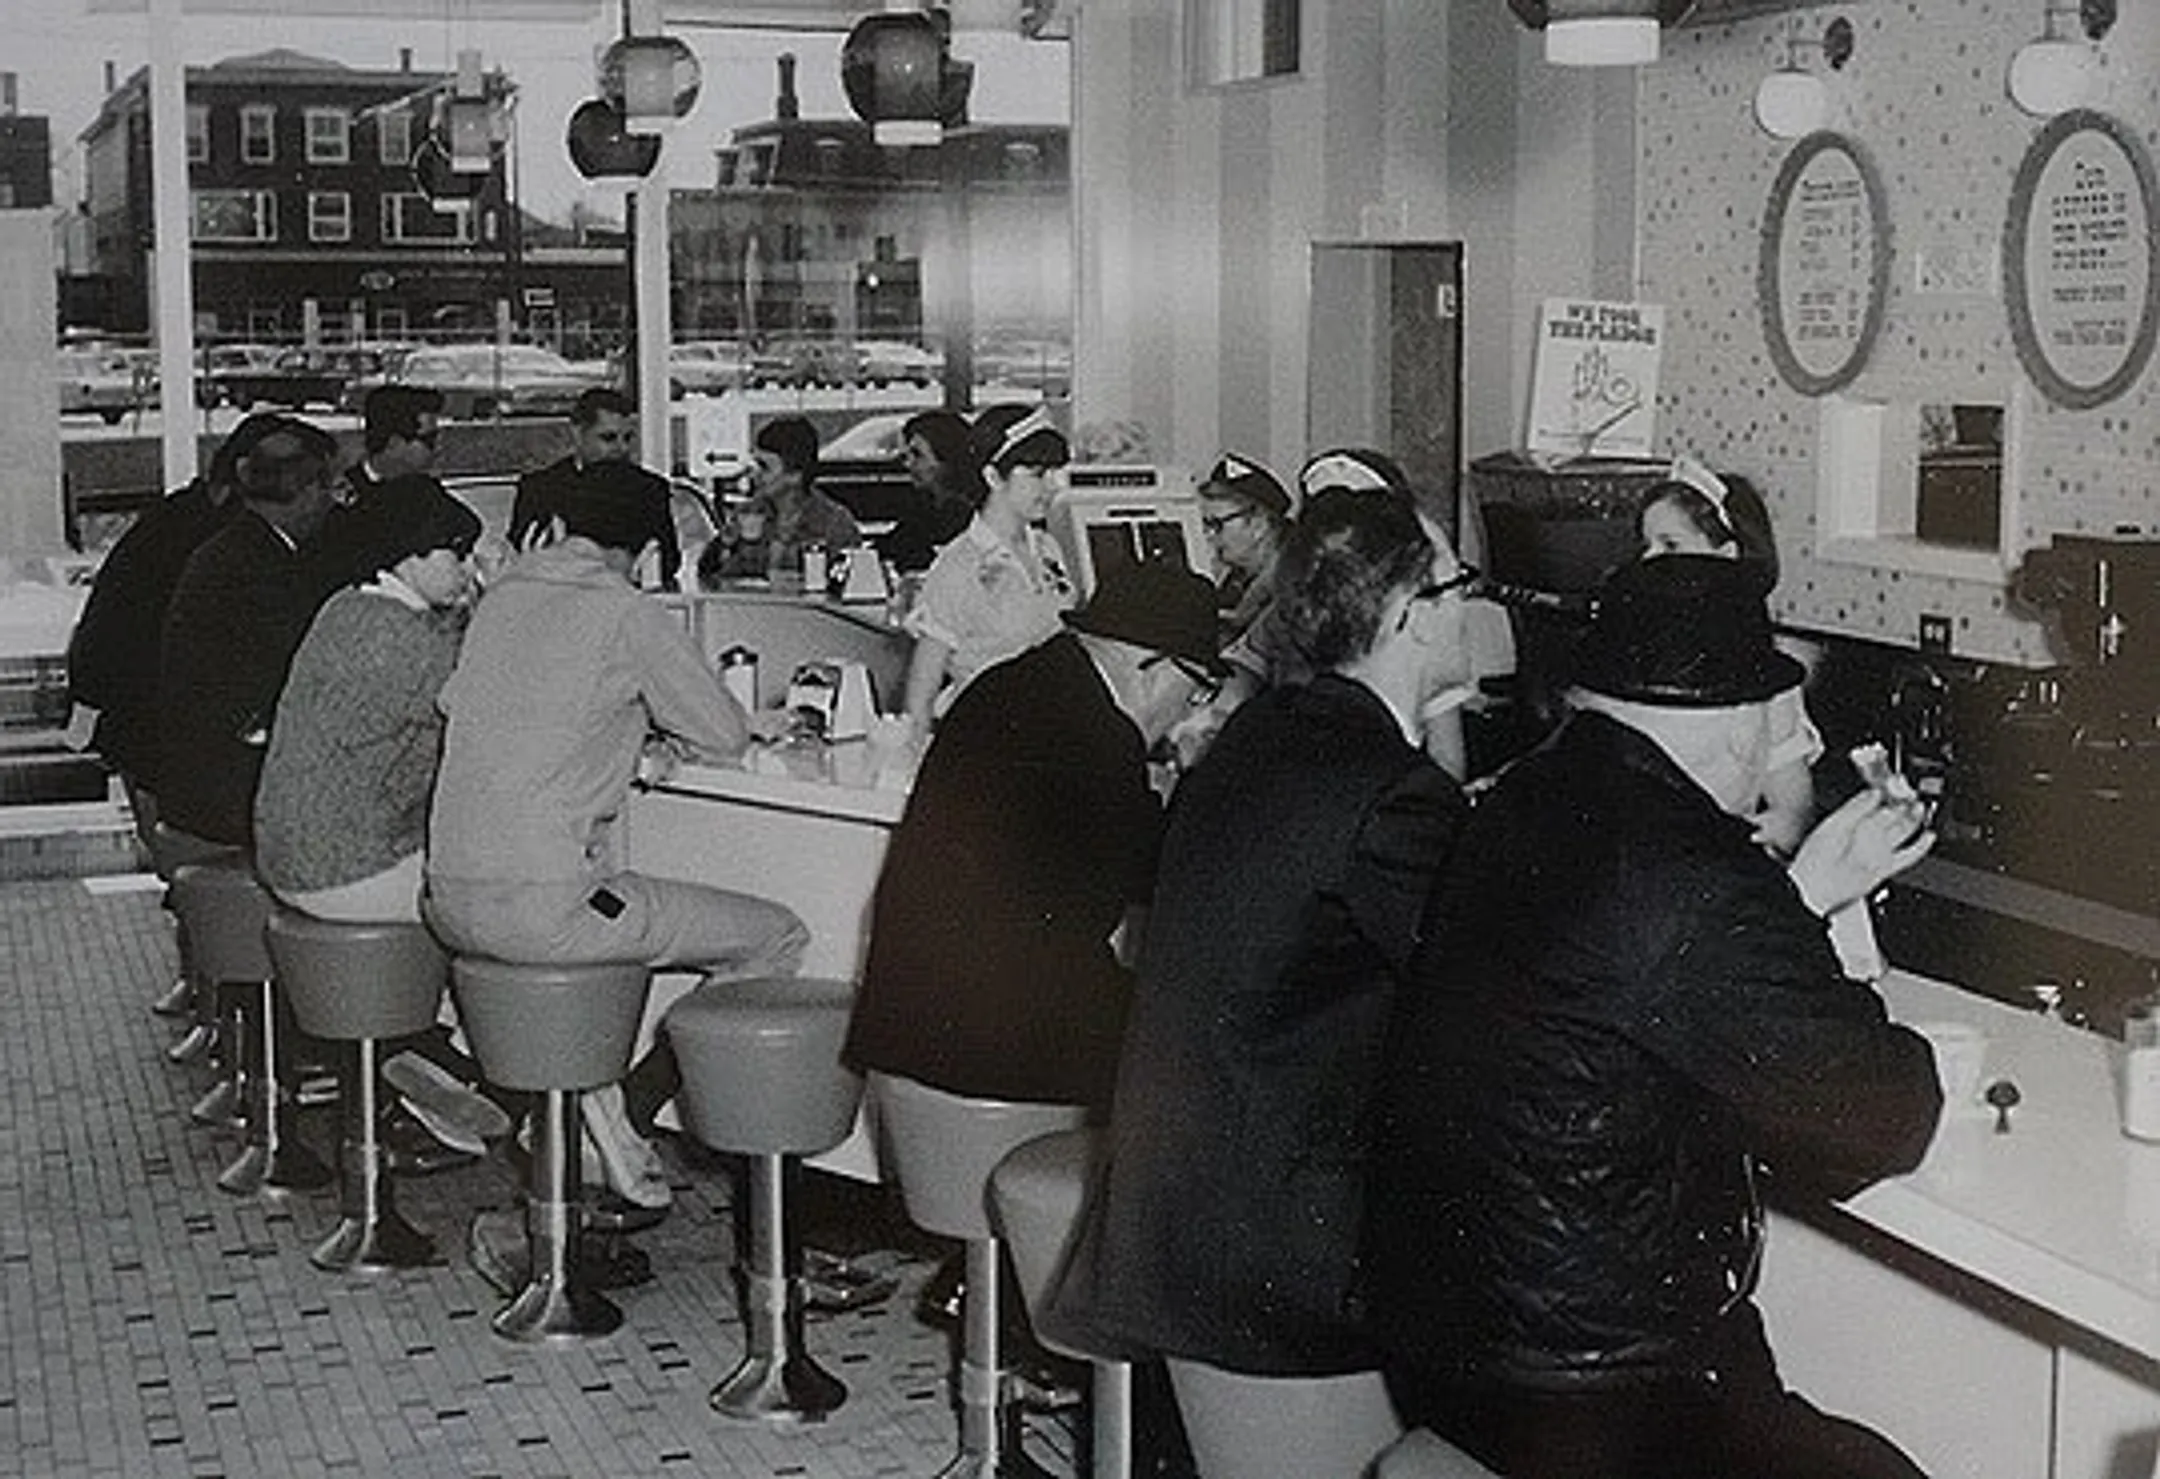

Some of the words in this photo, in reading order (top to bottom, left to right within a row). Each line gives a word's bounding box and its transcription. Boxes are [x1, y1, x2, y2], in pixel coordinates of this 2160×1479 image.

[1567, 304, 1595, 321] WE
[1548, 320, 1584, 338] THE
[1588, 323, 1656, 345] PLEDGE
